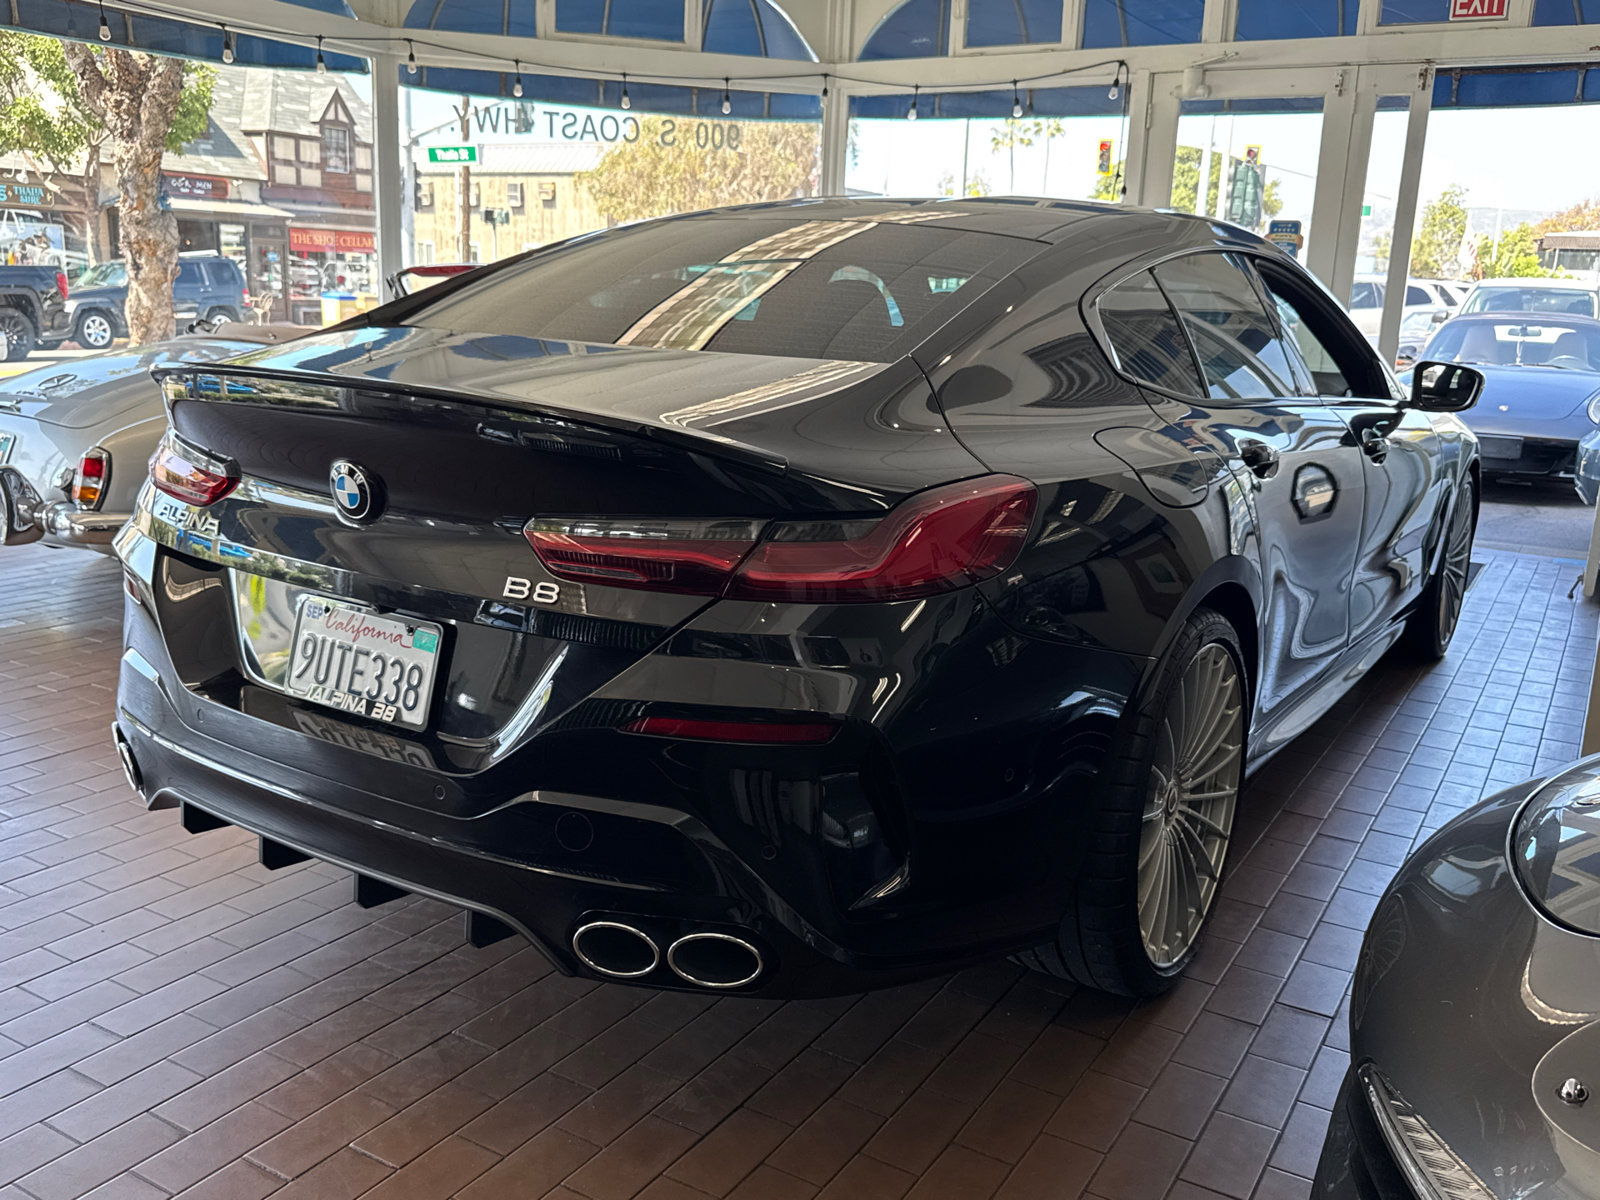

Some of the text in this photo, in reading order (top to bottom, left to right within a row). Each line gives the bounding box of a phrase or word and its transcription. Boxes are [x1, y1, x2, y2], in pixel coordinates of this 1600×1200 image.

[292, 232, 313, 245] THE
[159, 503, 220, 536] ALPINA
[503, 576, 560, 604] B8
[306, 603, 323, 620] SEP
[324, 606, 412, 649] California
[295, 632, 423, 712] 9UTE338
[308, 685, 367, 714] ALPINA
